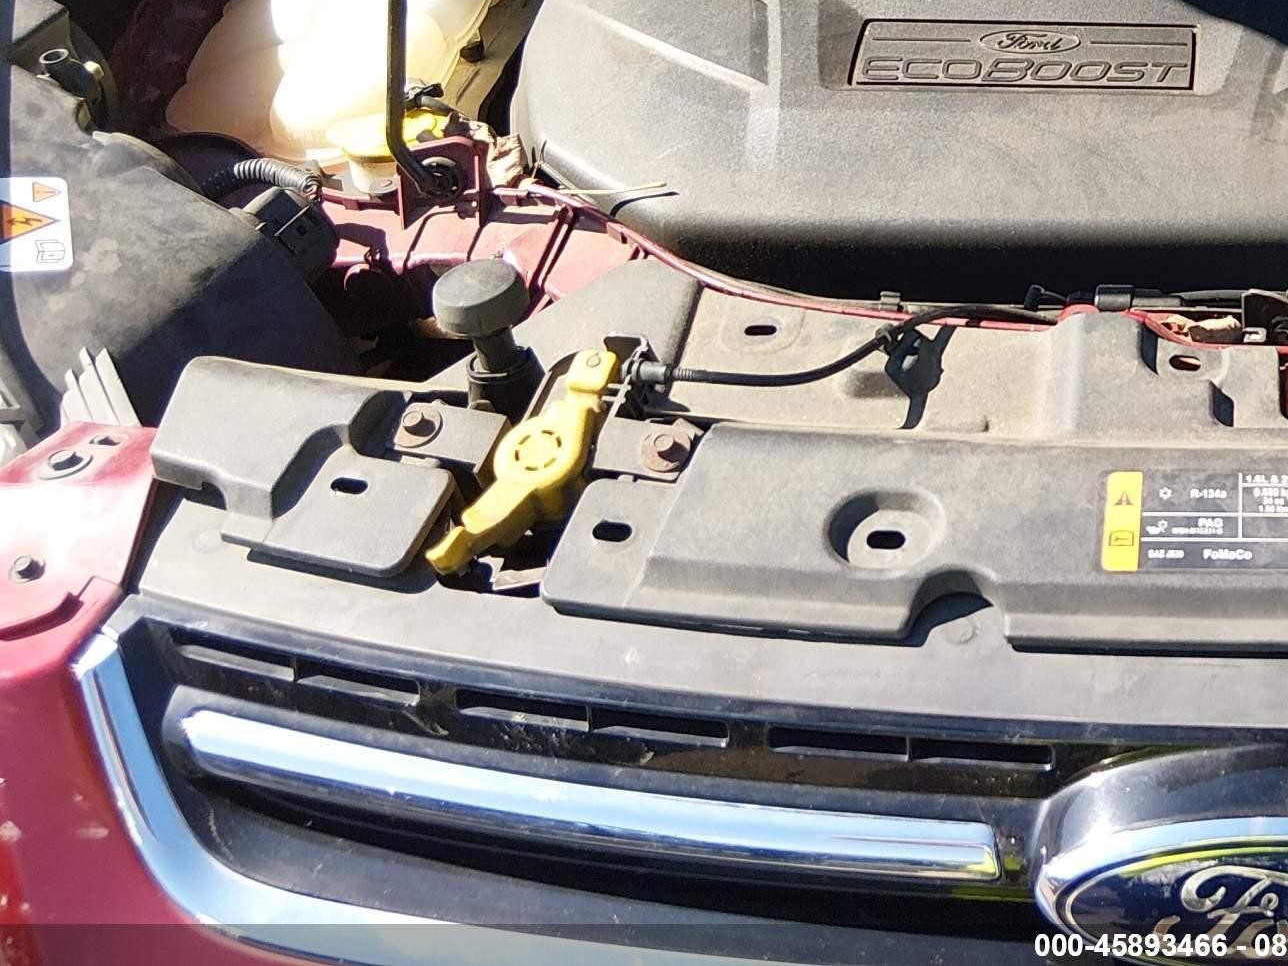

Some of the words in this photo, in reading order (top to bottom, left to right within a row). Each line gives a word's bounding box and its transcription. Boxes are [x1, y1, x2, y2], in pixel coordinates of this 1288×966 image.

[997, 32, 1063, 50] Ford
[861, 56, 1188, 83] ECOBOOST
[1190, 488, 1227, 499] R-134a
[1198, 517, 1223, 527] PAG
[1203, 548, 1253, 560] FoMoCo
